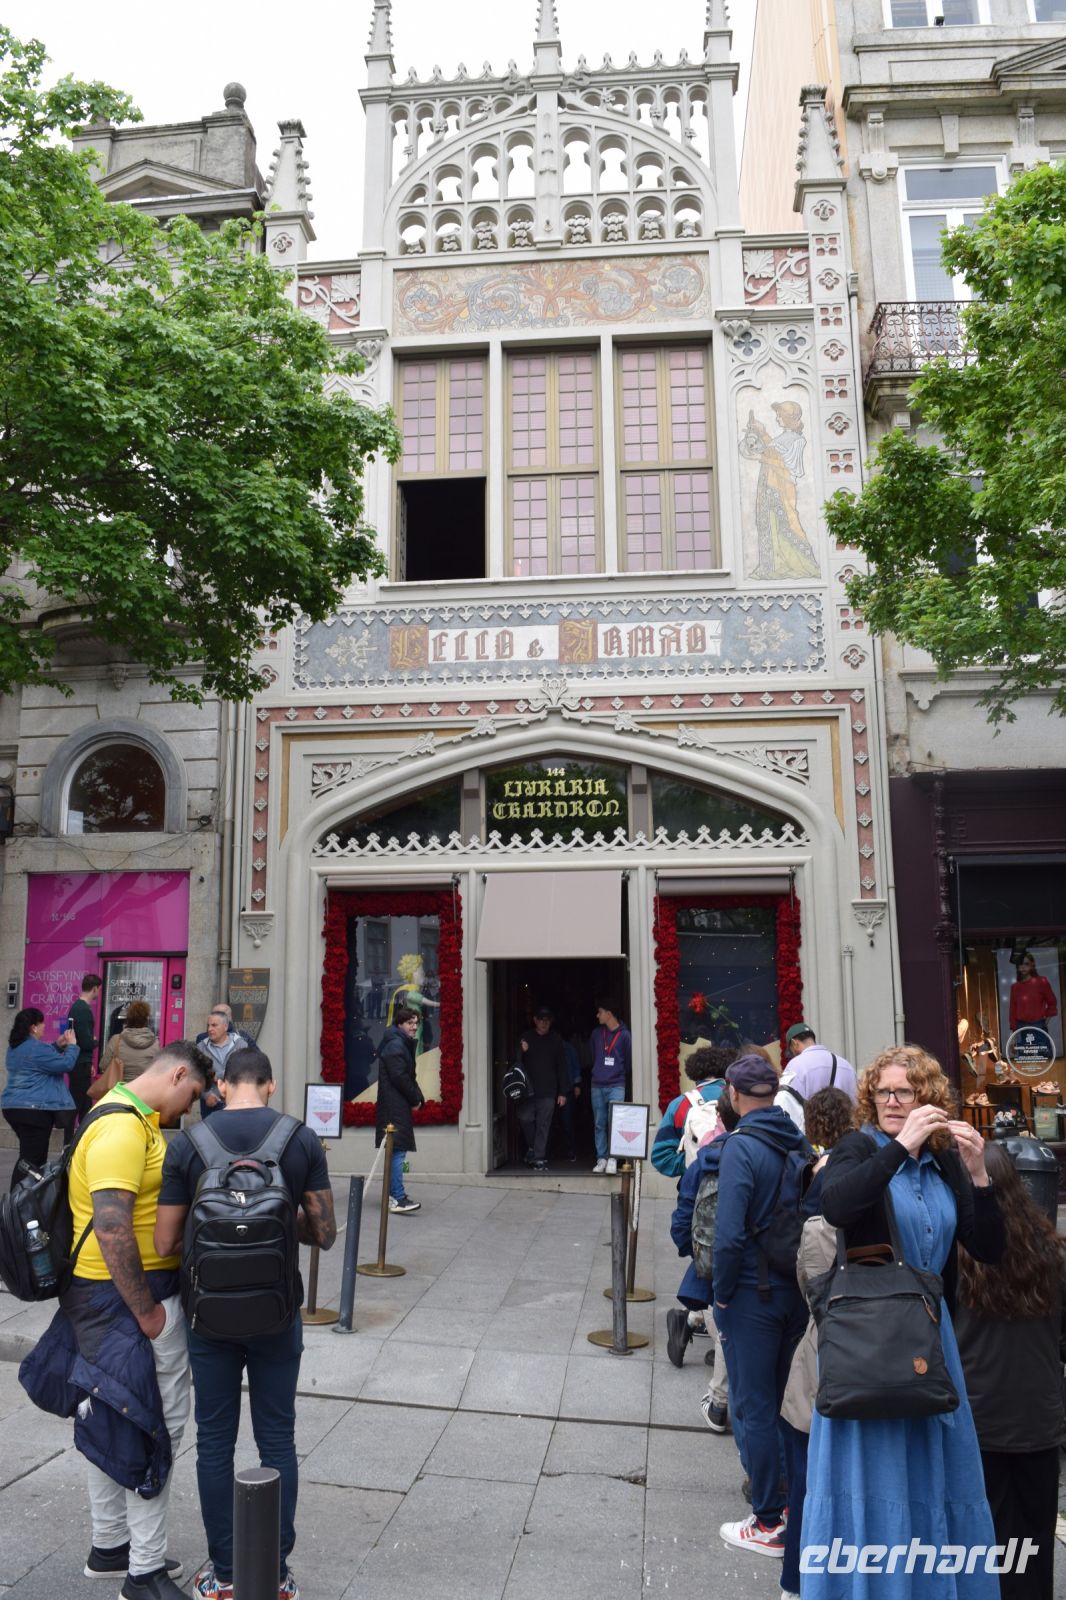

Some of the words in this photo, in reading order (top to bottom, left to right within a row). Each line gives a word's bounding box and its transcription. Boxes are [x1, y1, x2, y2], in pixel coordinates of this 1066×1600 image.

[527, 638, 545, 658] &
[546, 767, 566, 777] 144
[44, 982, 73, 993] YOUR
